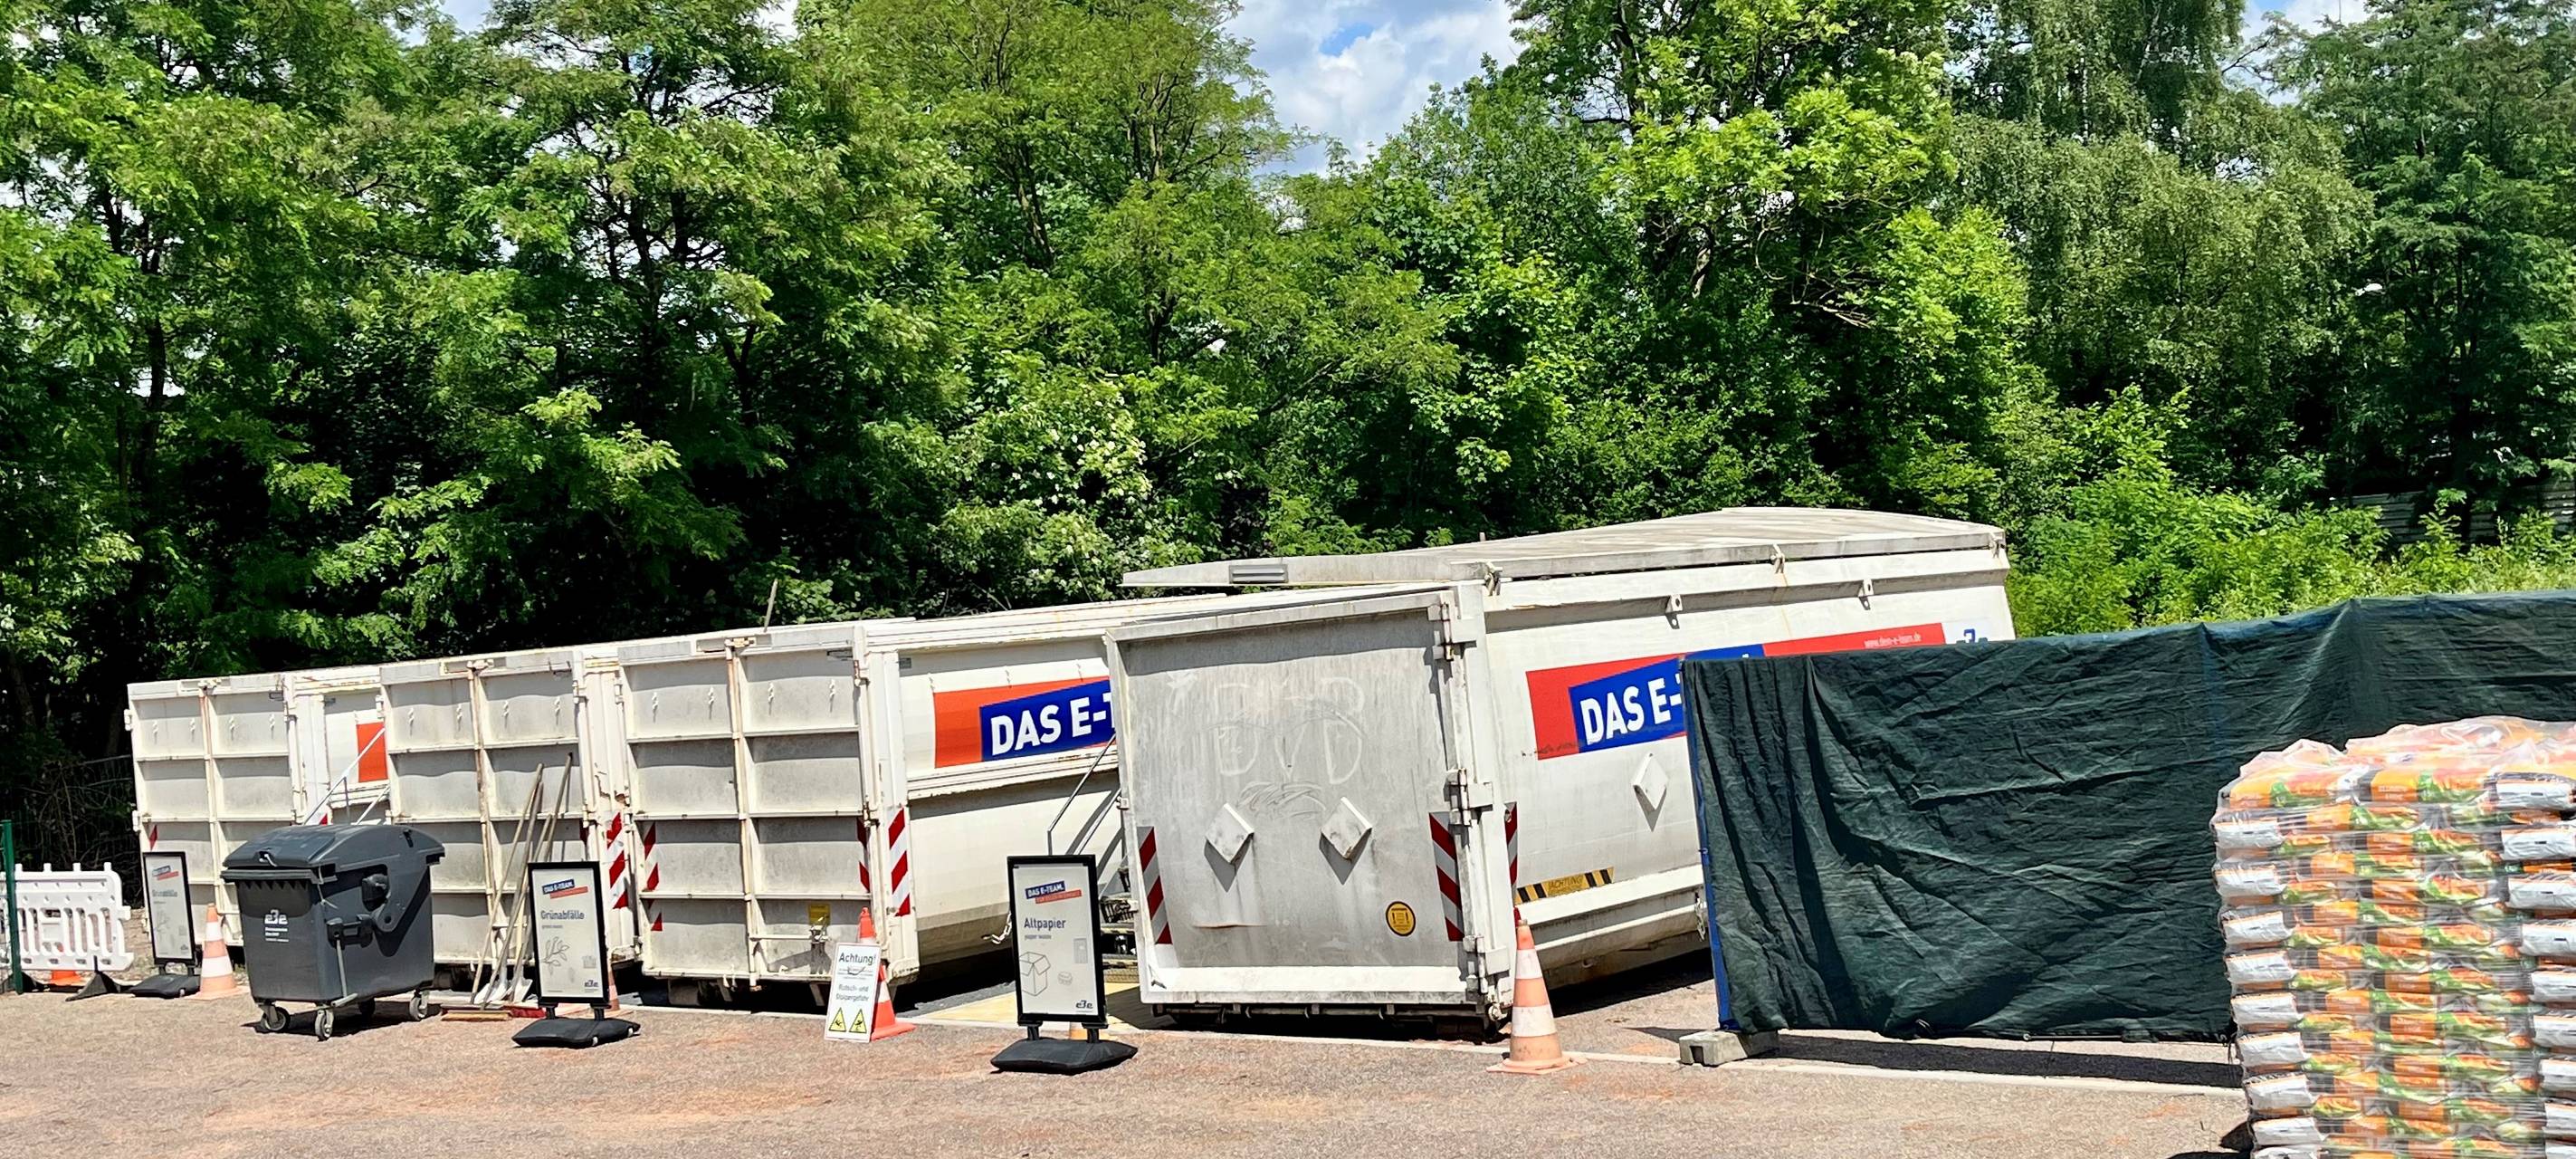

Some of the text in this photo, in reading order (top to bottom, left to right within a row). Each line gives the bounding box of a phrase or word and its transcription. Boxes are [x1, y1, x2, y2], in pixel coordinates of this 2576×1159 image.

[1580, 673, 1683, 745] DAS E-
[990, 704, 1062, 756] DAS
[1027, 887, 1040, 897] DAS
[1024, 917, 1066, 931] Altpapier
[838, 952, 877, 966] Achtung!
